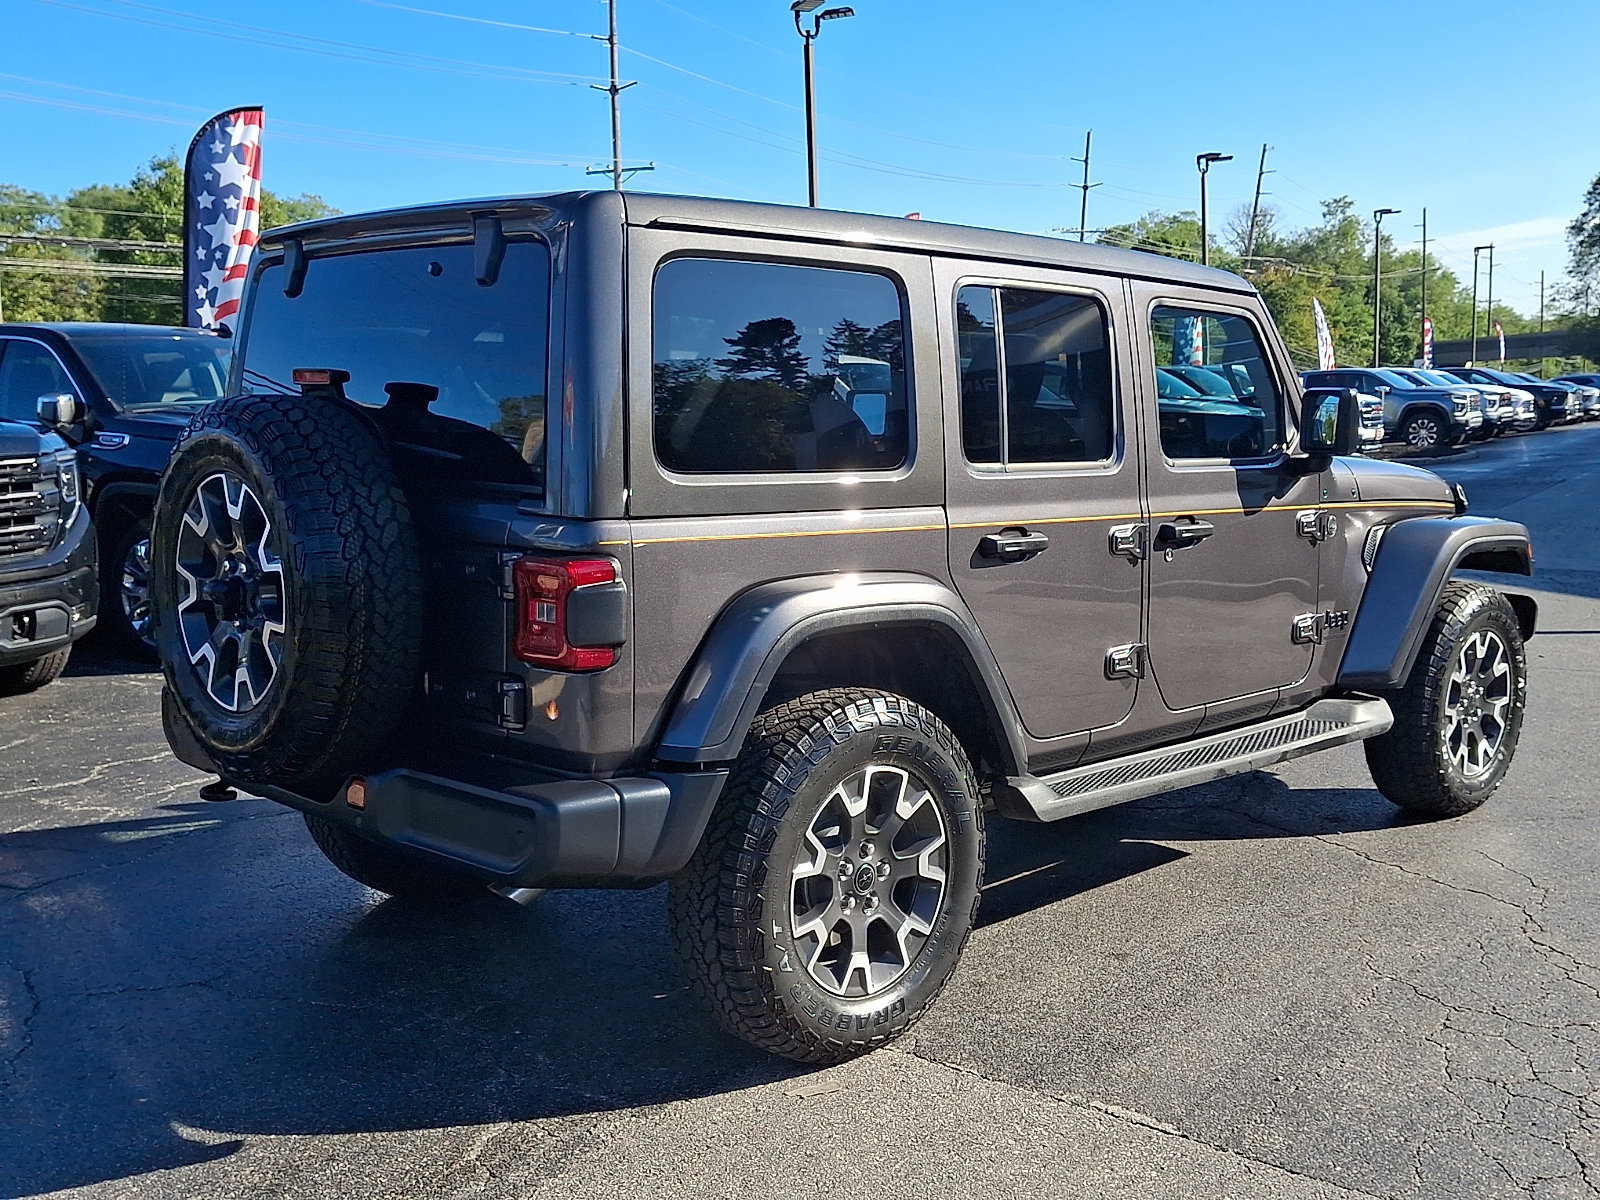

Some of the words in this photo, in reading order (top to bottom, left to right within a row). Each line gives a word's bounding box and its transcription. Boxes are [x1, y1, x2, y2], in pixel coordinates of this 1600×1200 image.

[1324, 610, 1348, 630] Jeep
[872, 734, 971, 835] GENERAL
[772, 919, 793, 972] A/T
[790, 984, 906, 1033] GRABBER
